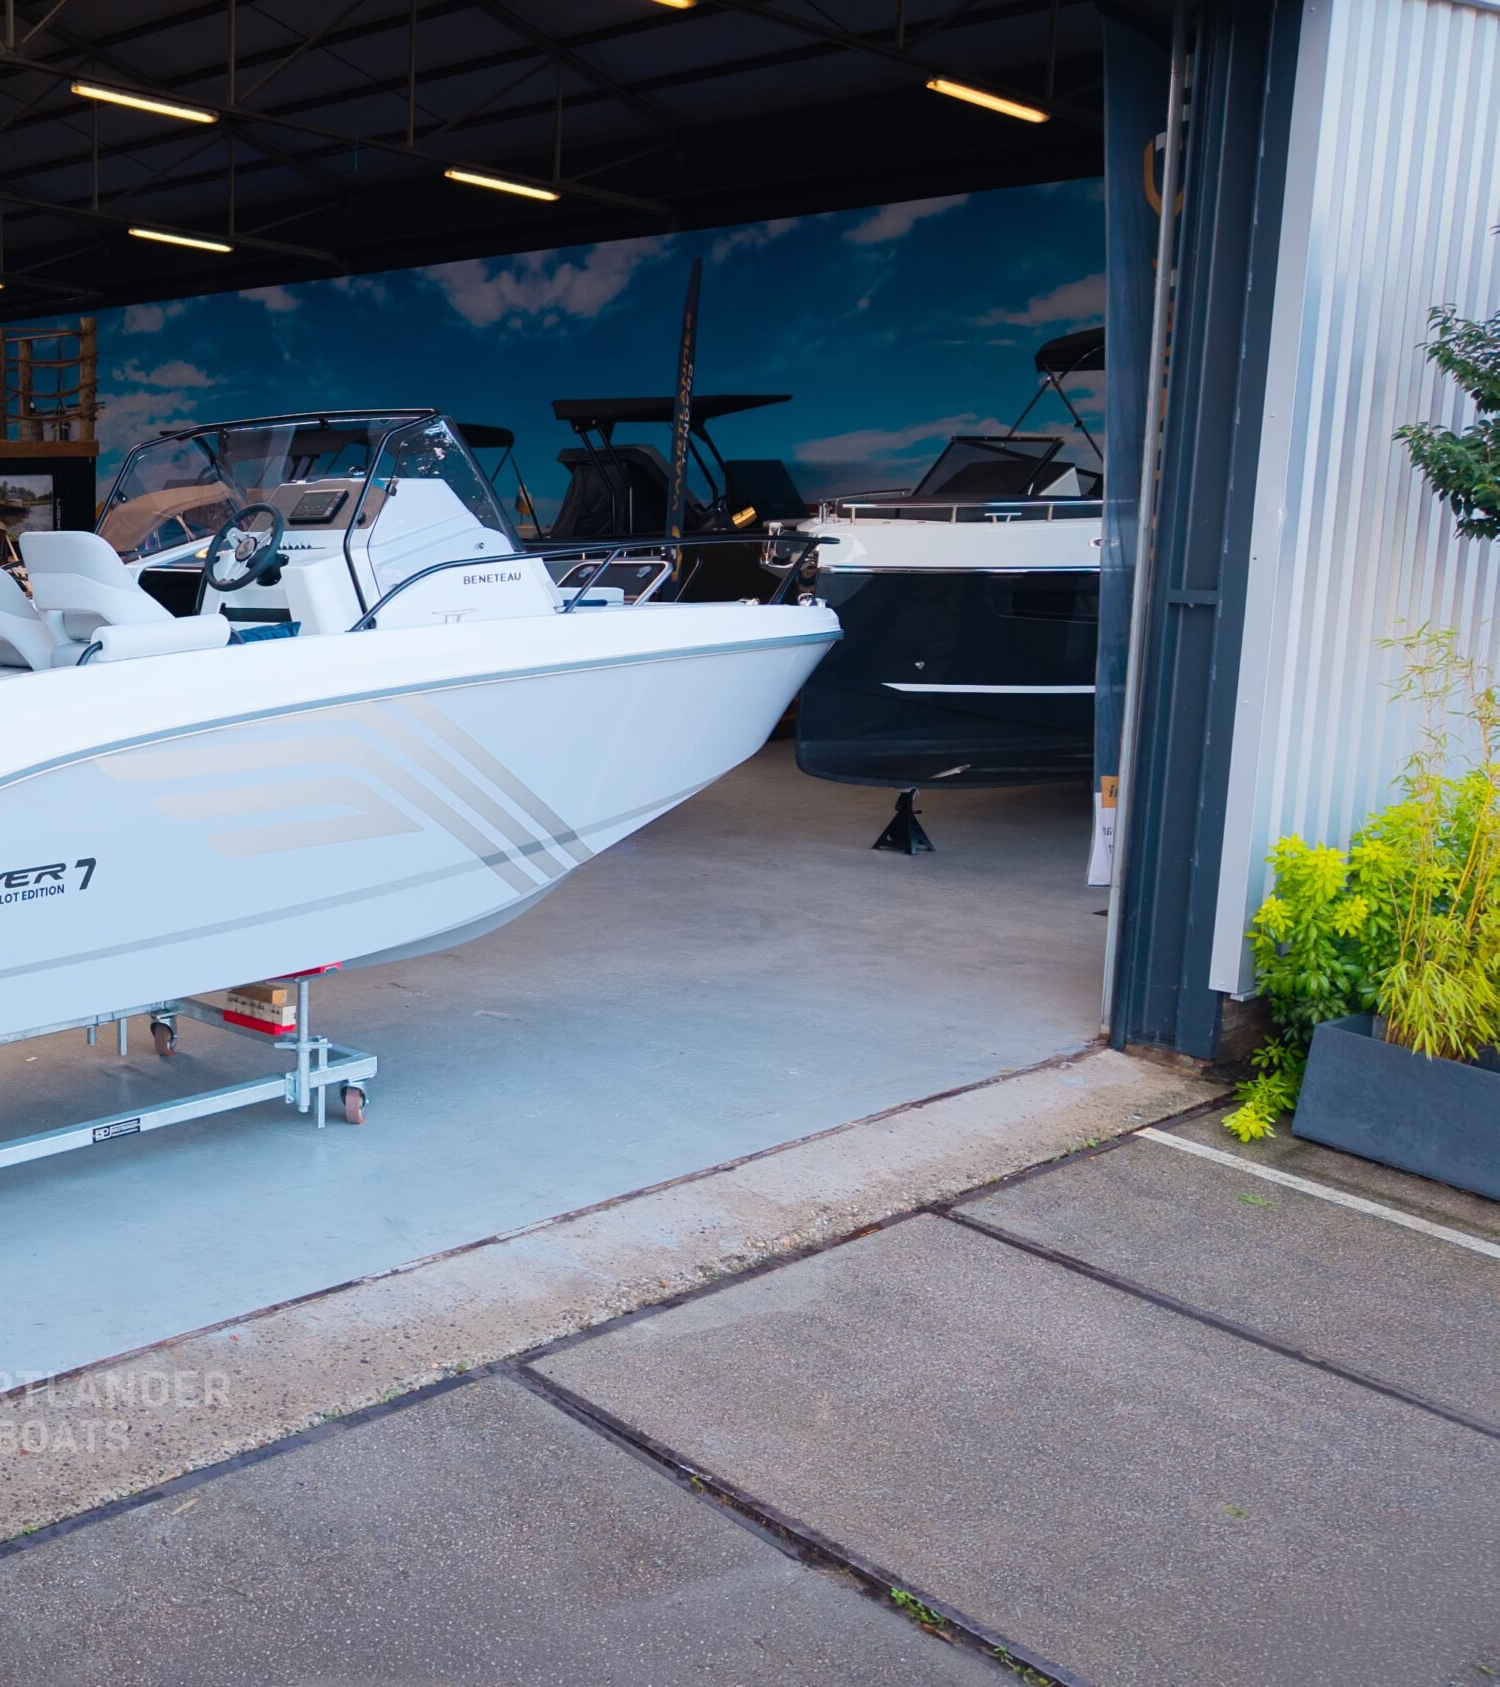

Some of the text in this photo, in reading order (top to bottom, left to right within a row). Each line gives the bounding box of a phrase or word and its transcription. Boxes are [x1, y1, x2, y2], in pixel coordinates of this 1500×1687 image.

[463, 572, 521, 584] BENETEAU
[74, 857, 97, 890] 7
[21, 884, 65, 901] EDITION
